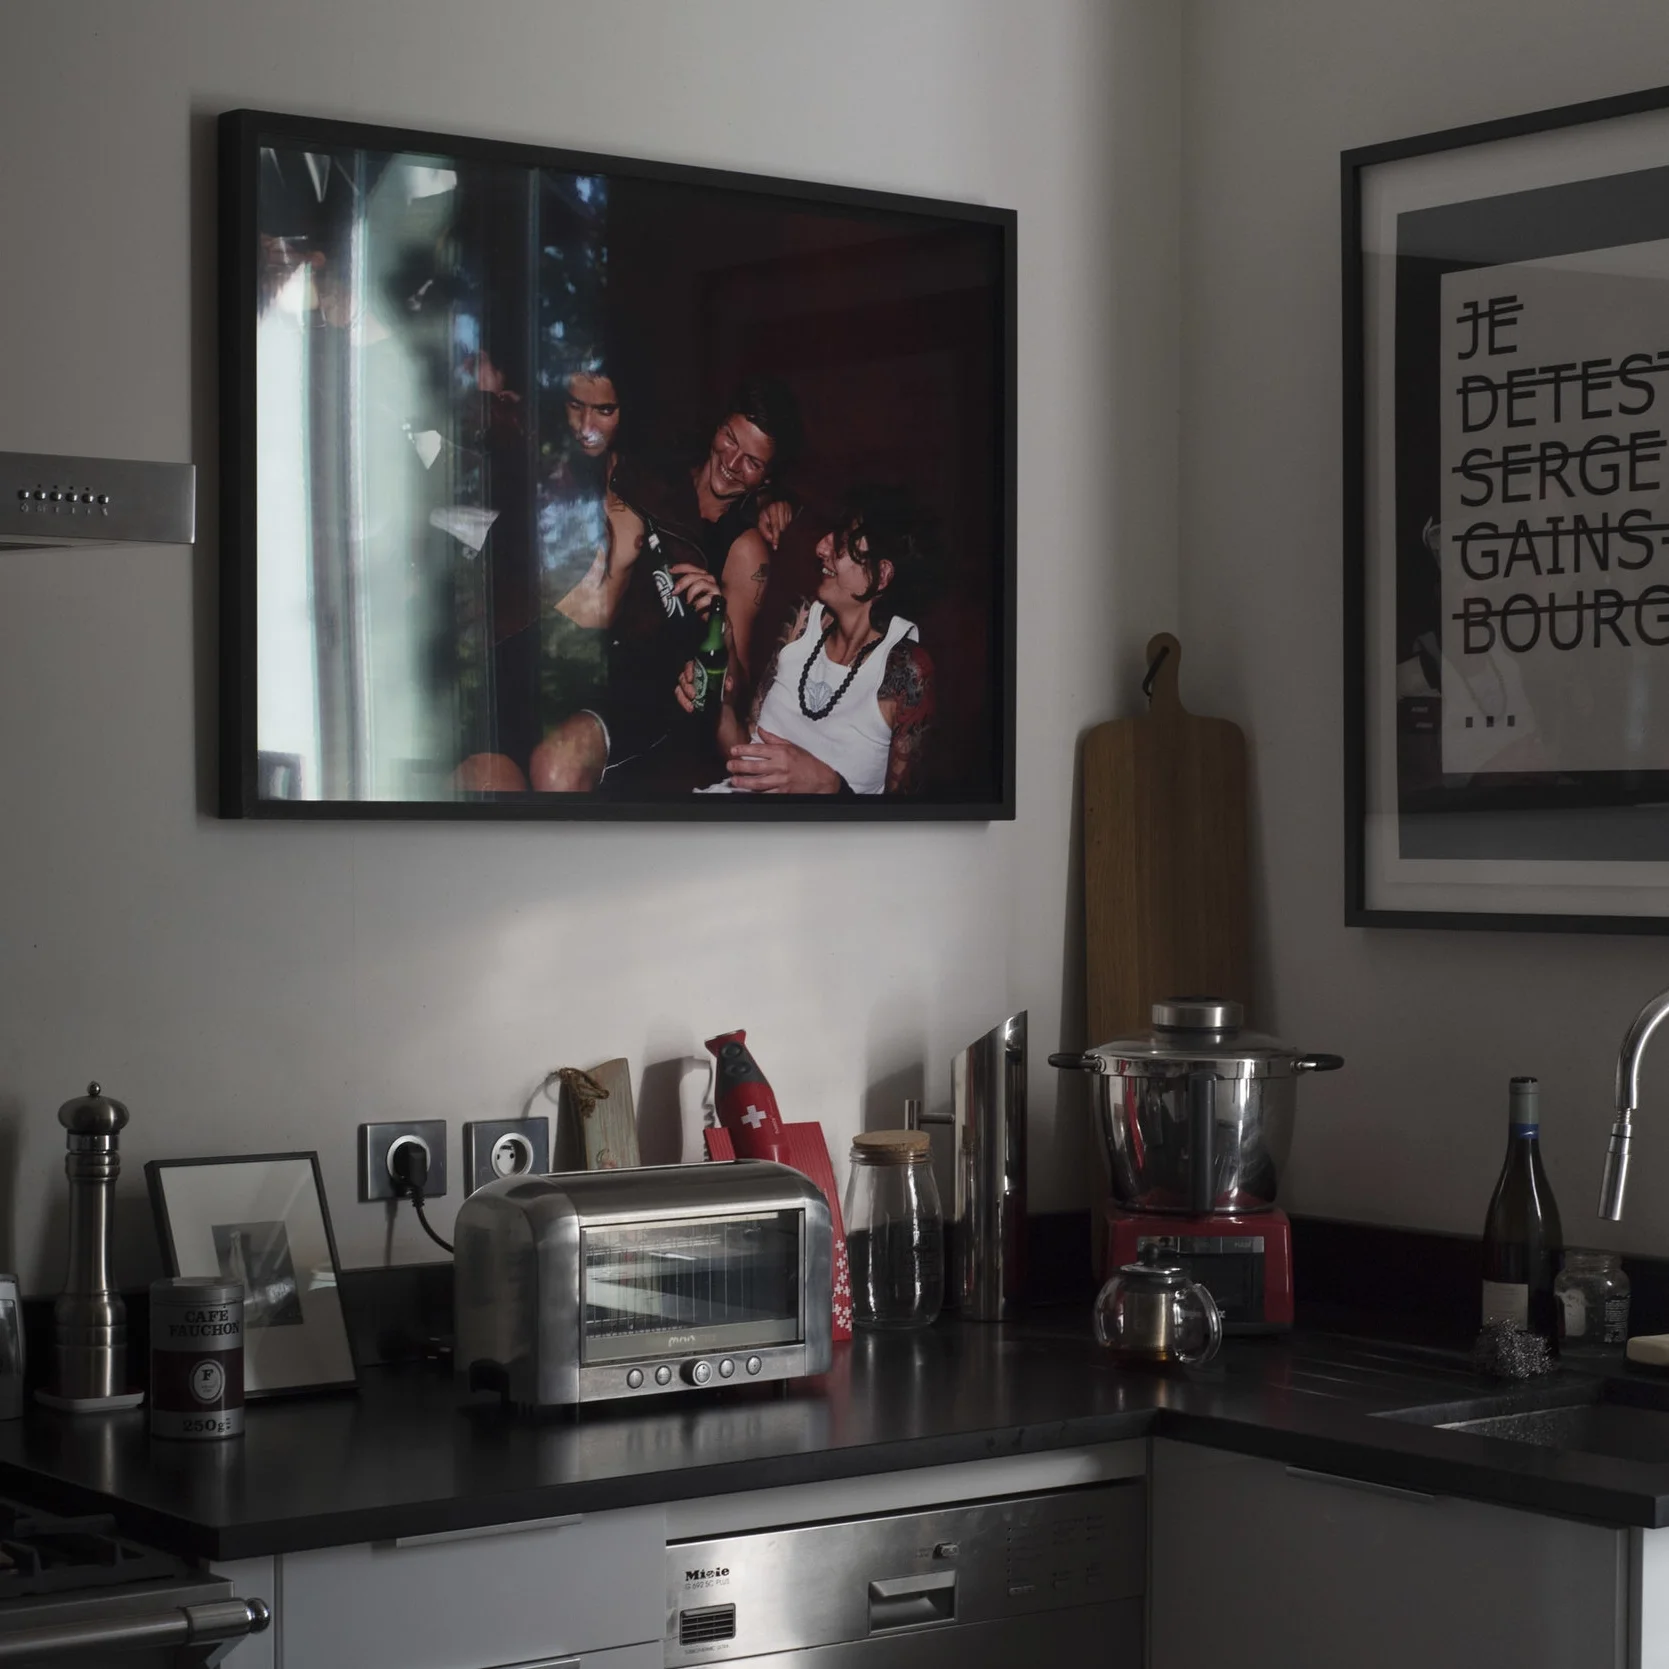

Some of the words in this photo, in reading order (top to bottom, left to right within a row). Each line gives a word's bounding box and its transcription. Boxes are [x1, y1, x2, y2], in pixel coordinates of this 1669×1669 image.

[1458, 295, 1518, 359] JE
[1460, 351, 1669, 433] DETES
[1459, 430, 1663, 507] SERGE
[1462, 585, 1669, 654] BOURG
[168, 1320, 240, 1338] FAUCHON
[201, 1368, 214, 1381] F
[685, 1567, 730, 1582] Miele
